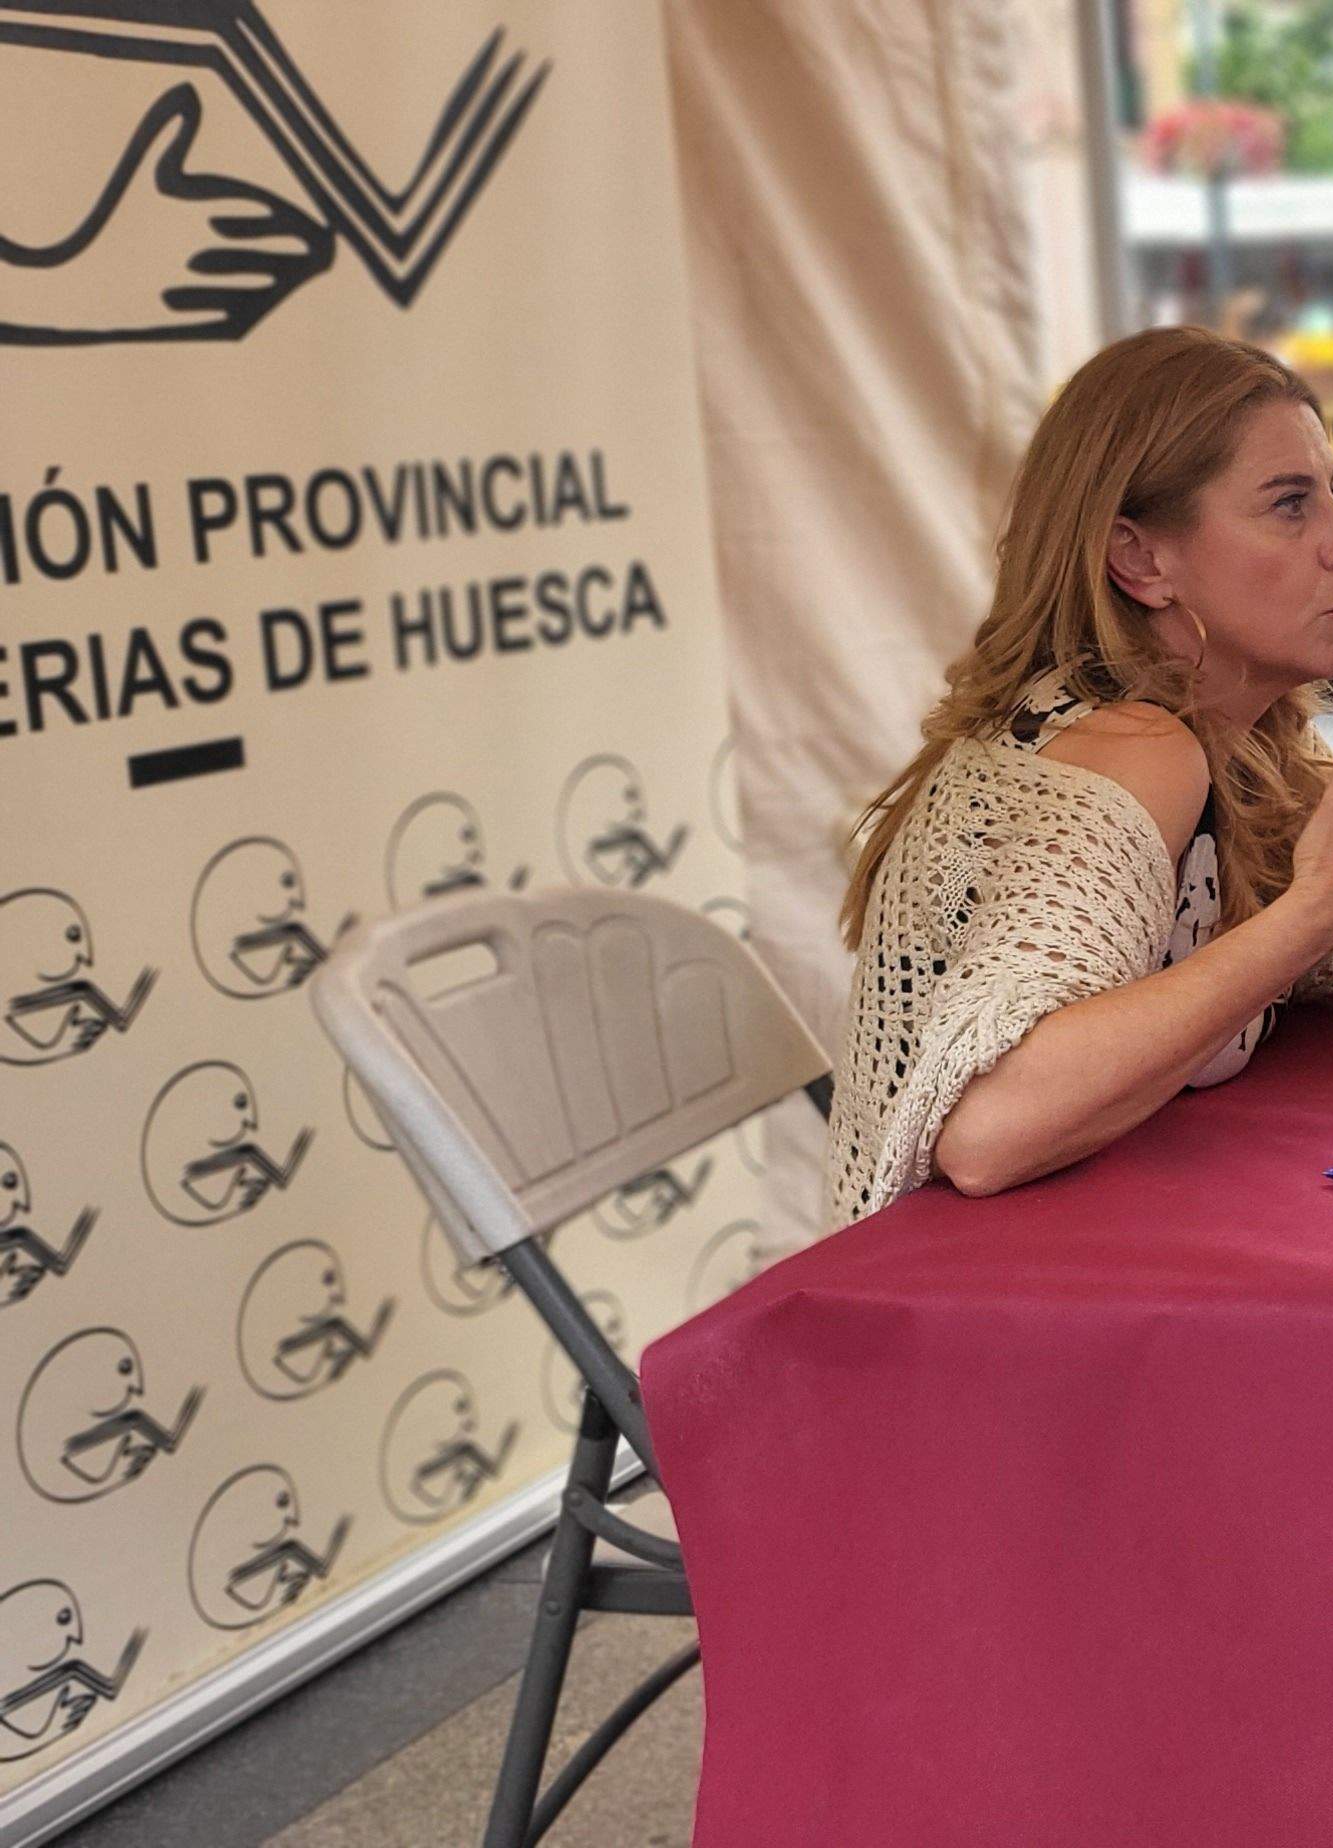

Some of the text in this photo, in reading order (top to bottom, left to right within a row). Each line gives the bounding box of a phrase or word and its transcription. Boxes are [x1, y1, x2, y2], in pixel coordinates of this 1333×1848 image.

[187, 447, 631, 565] PROVINCIAL
[259, 599, 371, 692] DE
[389, 560, 668, 672] HUESCA
